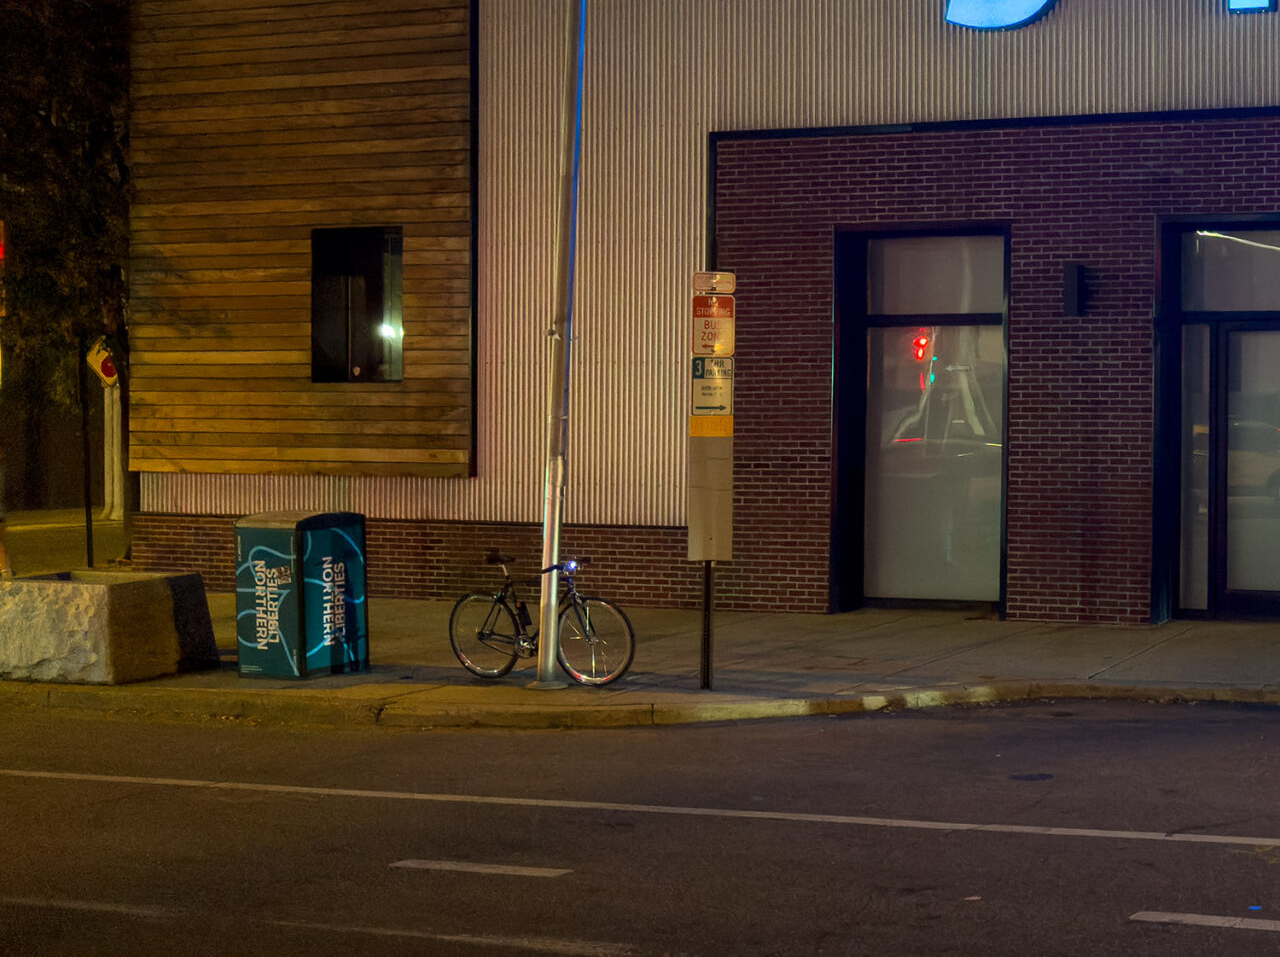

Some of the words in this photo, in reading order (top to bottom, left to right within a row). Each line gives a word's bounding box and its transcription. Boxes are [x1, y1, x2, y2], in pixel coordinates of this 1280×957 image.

[696, 307, 731, 316] STOPING
[701, 331, 721, 341] ZON
[695, 360, 702, 375] 3
[714, 359, 725, 368] HR
[254, 560, 268, 650] NORTHERN
[266, 567, 280, 643] LIBERTIES
[322, 556, 335, 646] NORTHERN
[334, 562, 345, 636] LIBERTIES
